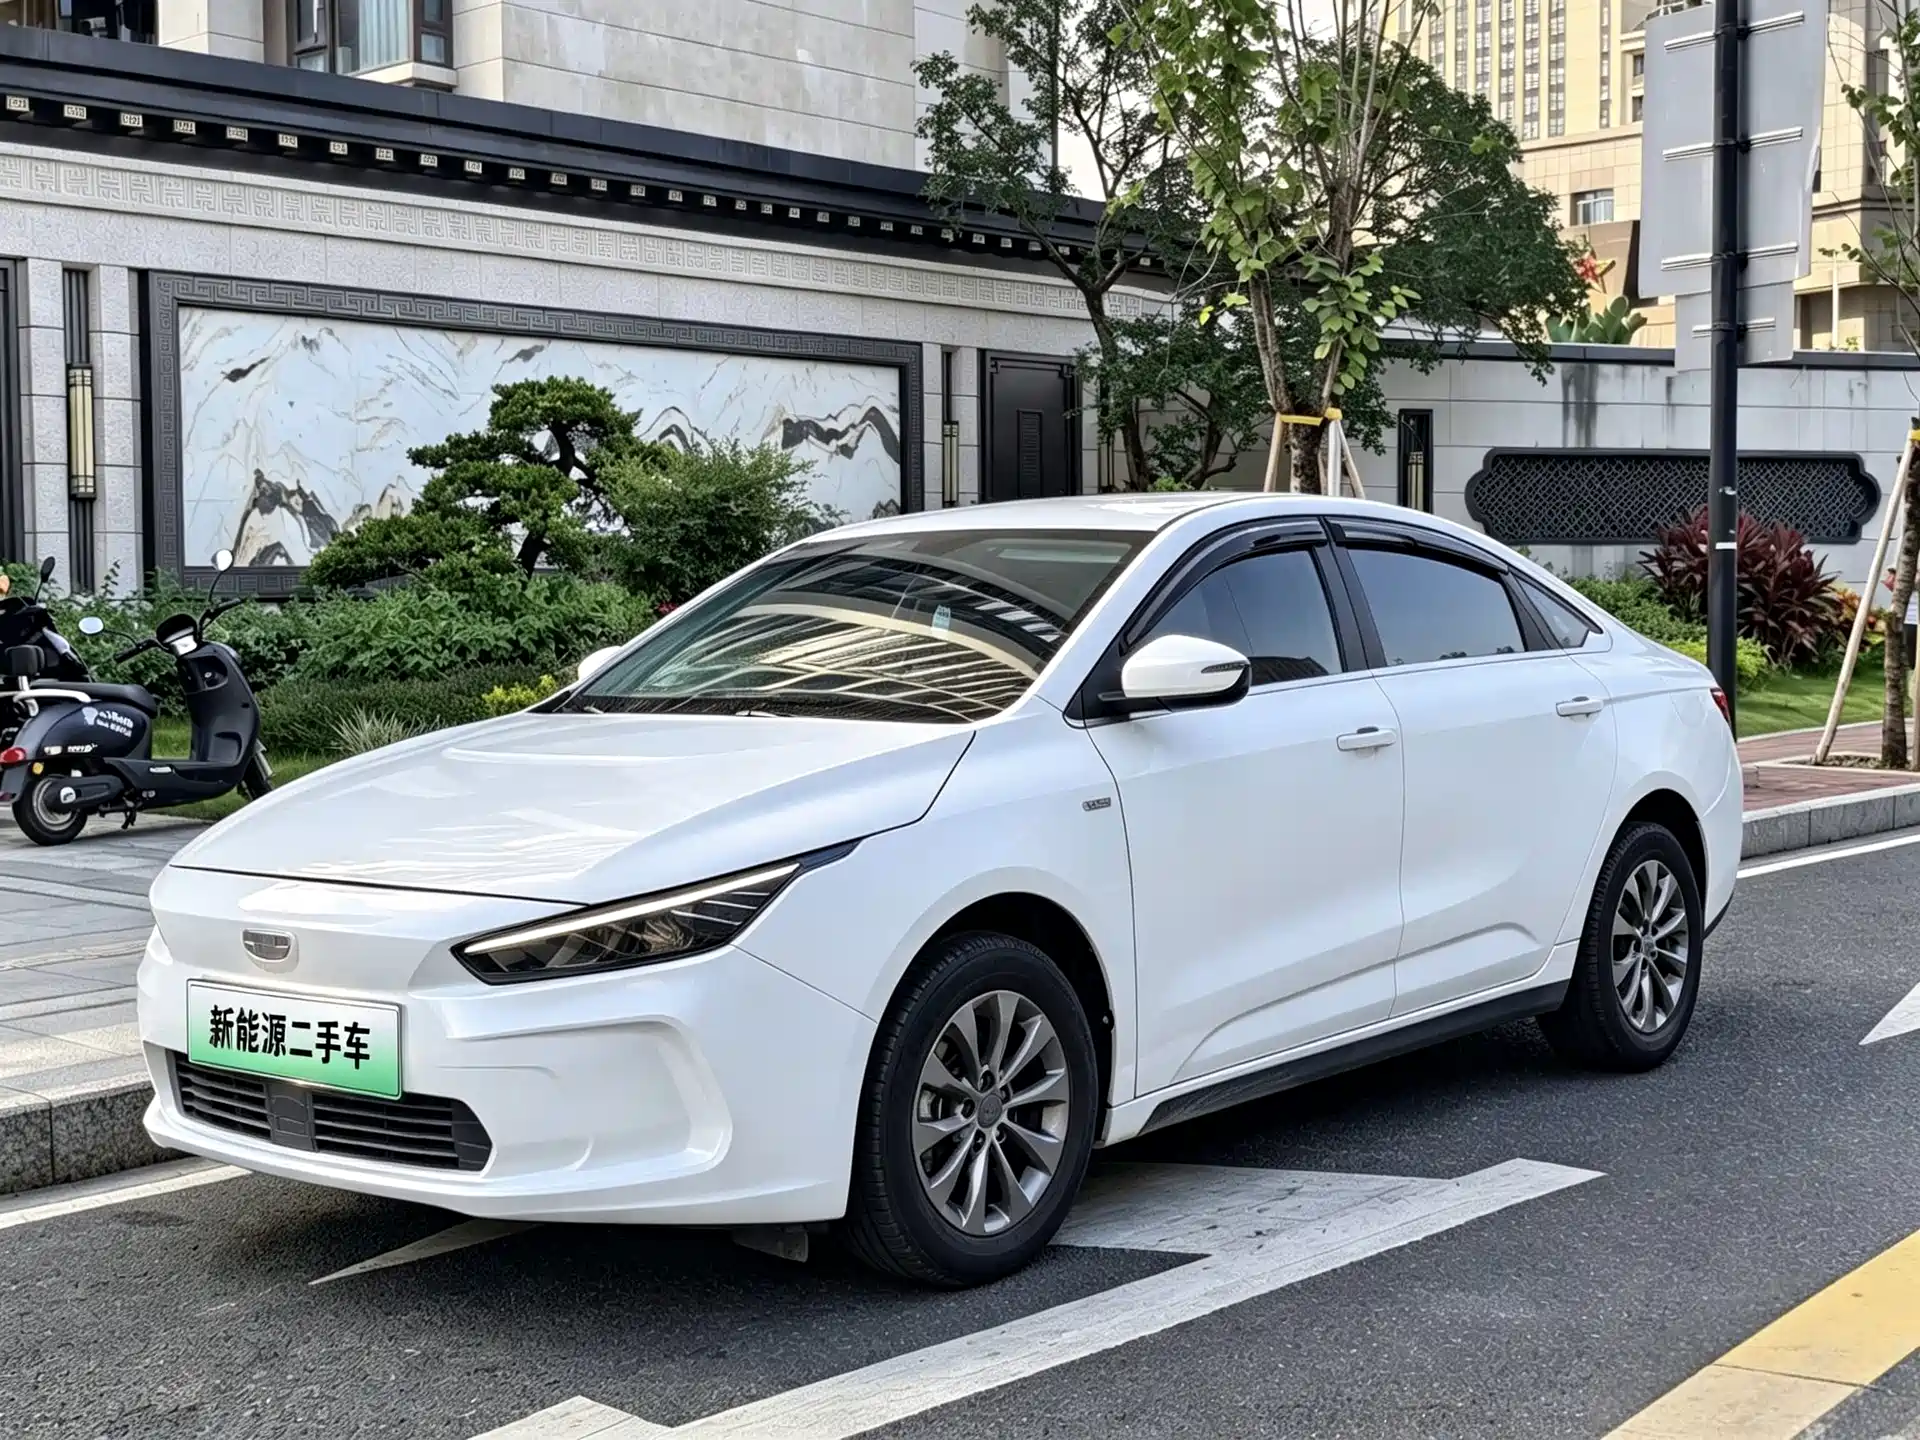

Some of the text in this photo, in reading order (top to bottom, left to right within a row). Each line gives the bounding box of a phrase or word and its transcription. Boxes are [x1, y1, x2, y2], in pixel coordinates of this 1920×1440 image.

[209, 1004, 371, 1070] 新能源二手车
